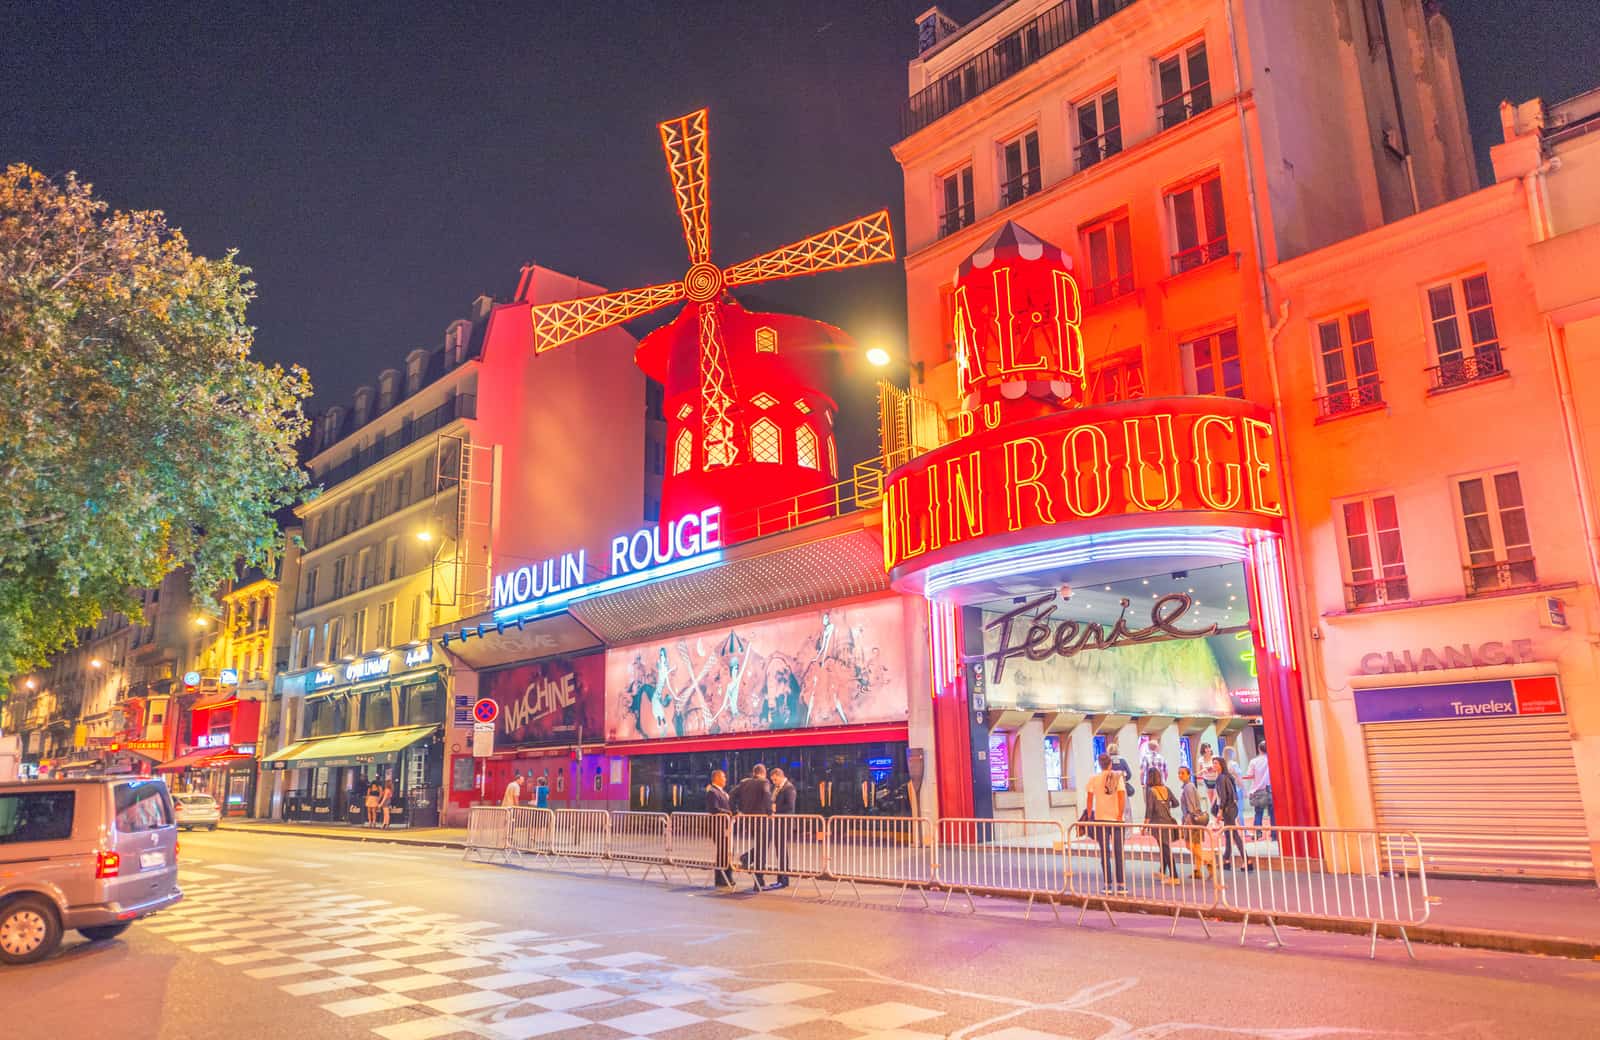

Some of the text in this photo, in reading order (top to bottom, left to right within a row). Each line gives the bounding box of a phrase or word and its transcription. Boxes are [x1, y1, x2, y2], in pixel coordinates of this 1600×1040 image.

[958, 401, 1001, 438] DU
[1003, 414, 1283, 531] ROUGE
[494, 506, 722, 607] MOULIN ROUGE
[985, 590, 1218, 684] Féerie
[1361, 638, 1536, 675] CHANGE
[504, 672, 577, 735] MACHINE
[1451, 699, 1513, 716] Travelex
